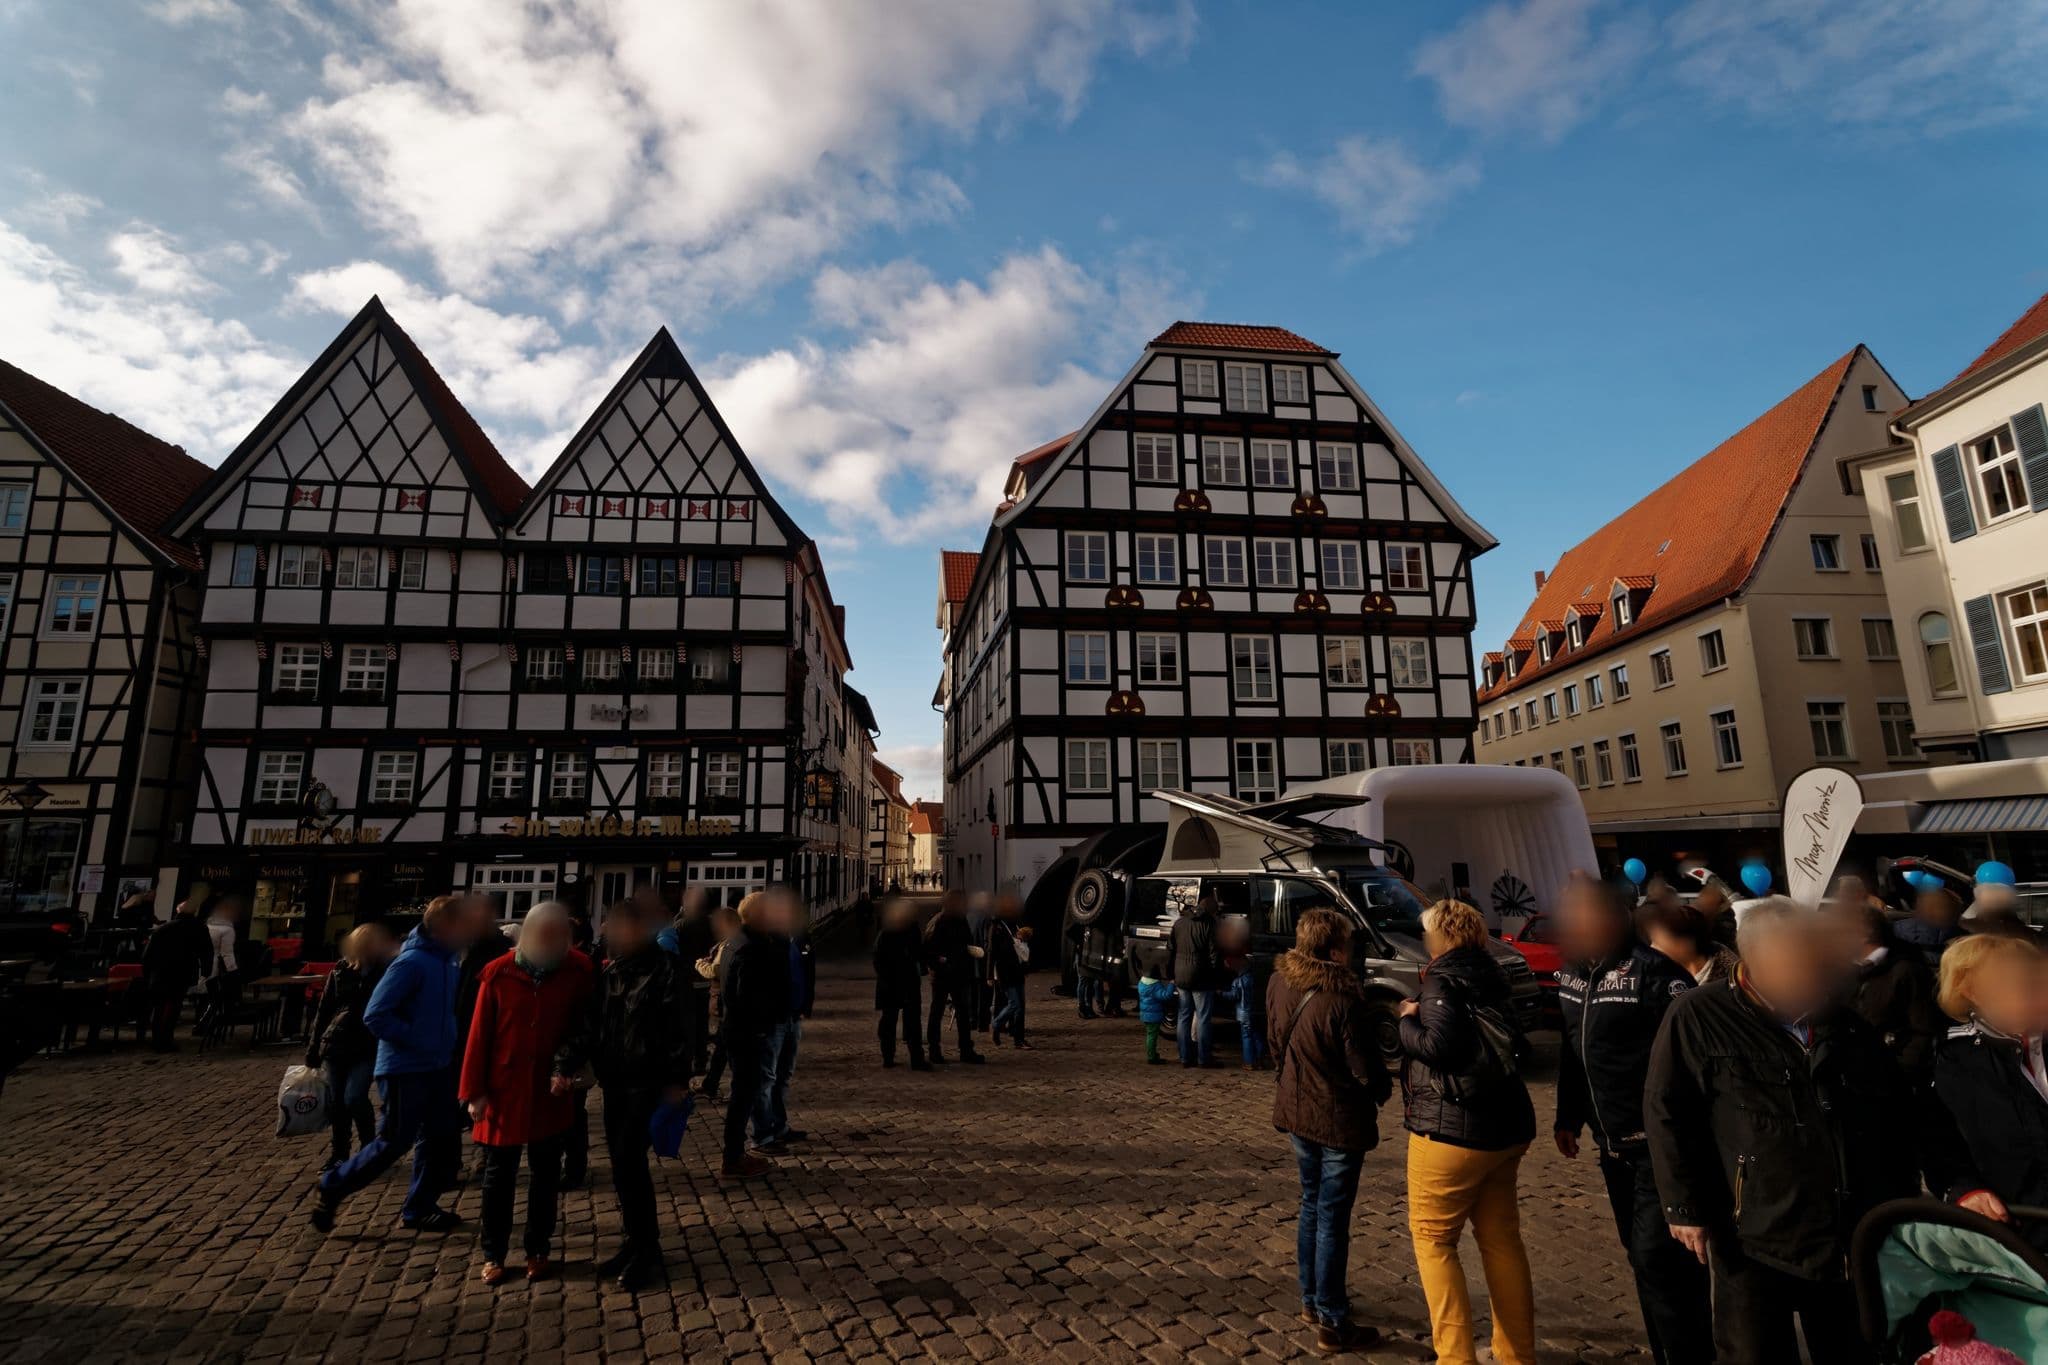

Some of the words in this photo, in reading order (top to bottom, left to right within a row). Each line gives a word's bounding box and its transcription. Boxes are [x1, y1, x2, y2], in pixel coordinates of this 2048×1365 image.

[591, 703, 649, 721] Hotel
[1802, 780, 1838, 839] Moritz
[252, 827, 323, 845] JUWELIER
[333, 826, 382, 844] RAABE
[659, 815, 732, 839] Mann
[1793, 834, 1825, 882] Max
[1596, 977, 1637, 992] CRAFT
